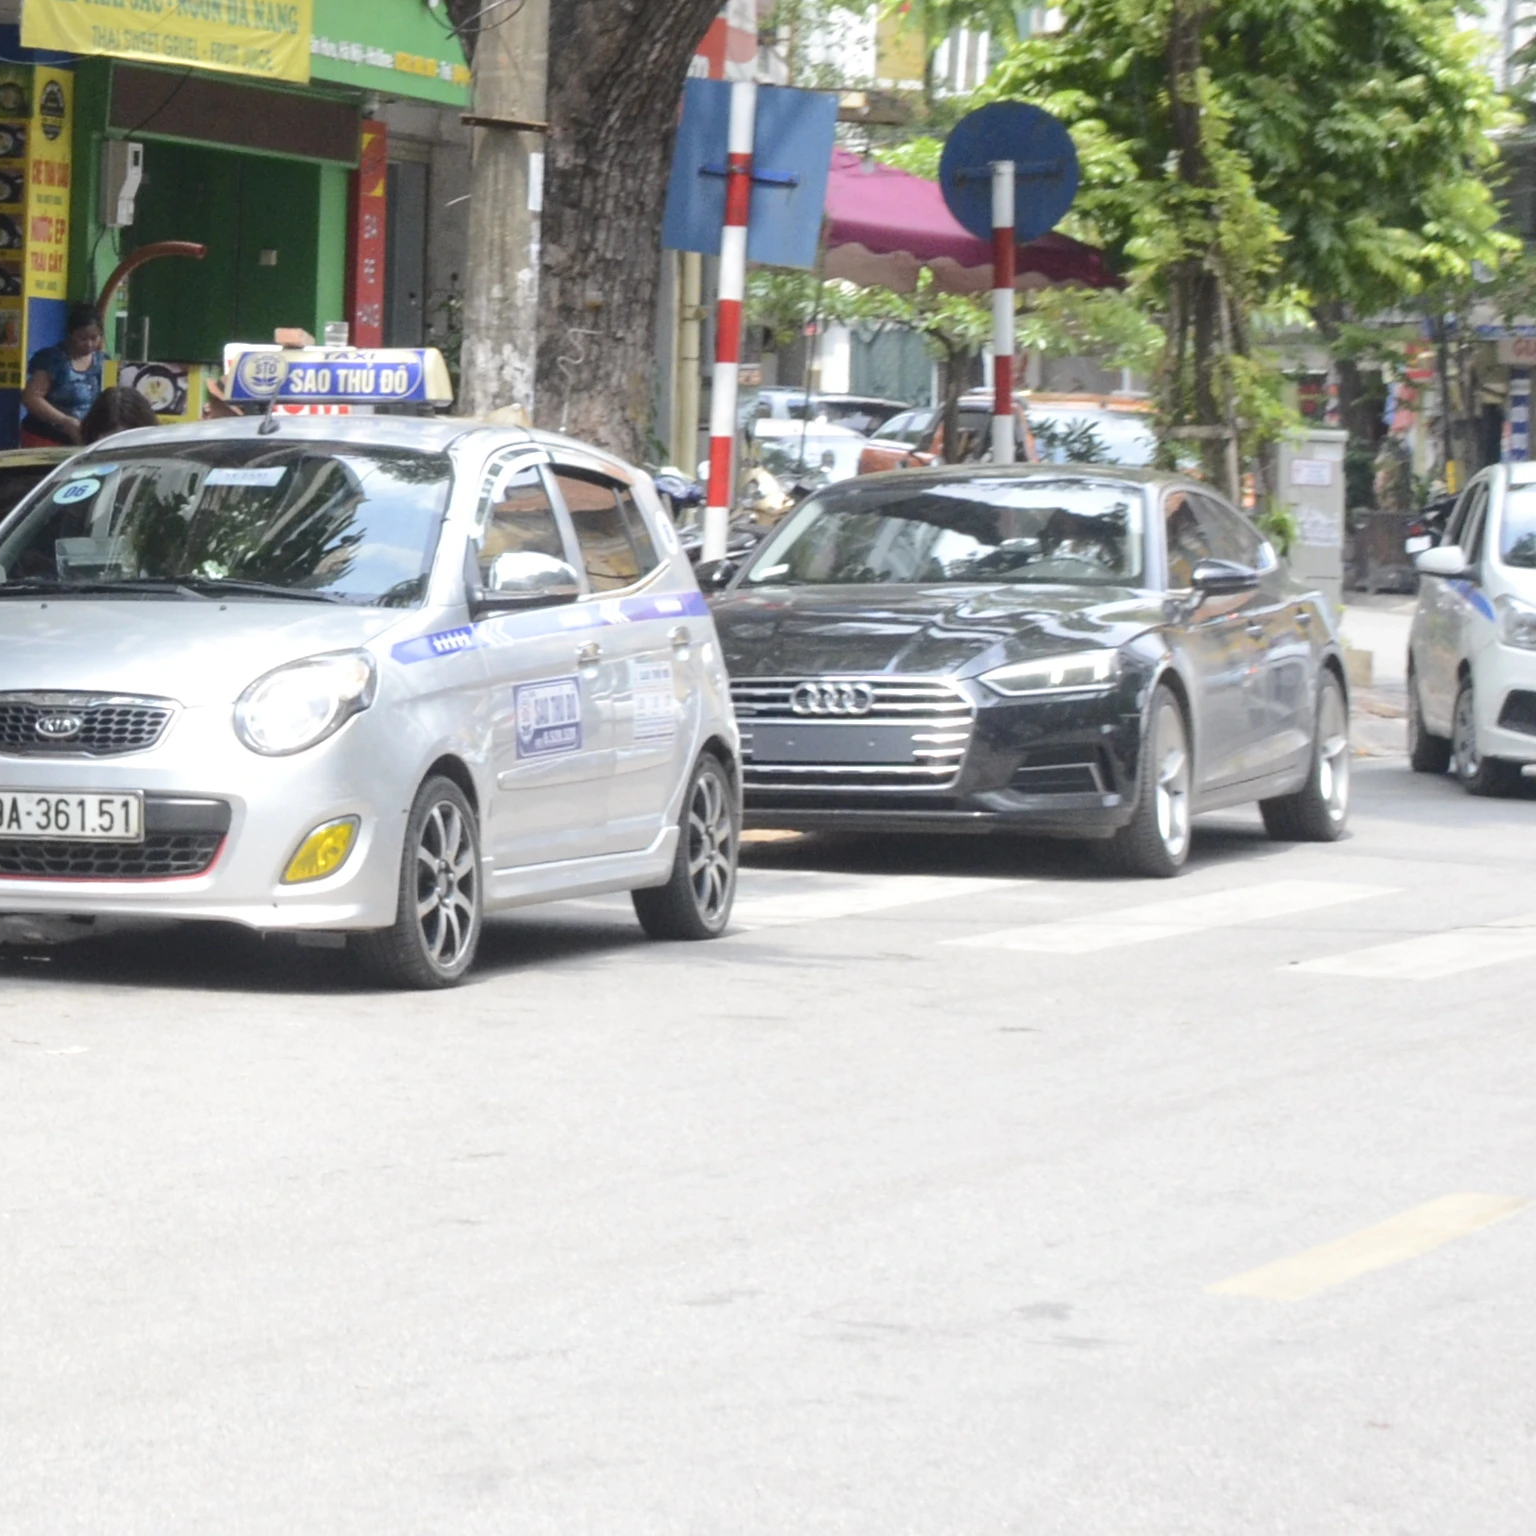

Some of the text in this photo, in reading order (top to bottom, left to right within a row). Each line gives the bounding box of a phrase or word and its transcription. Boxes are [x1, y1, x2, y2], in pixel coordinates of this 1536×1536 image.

[323, 352, 376, 362] TAXI
[289, 361, 409, 394] SAO THỦ ĐÔ
[61, 485, 87, 499] 06
[42, 719, 72, 732] KIA
